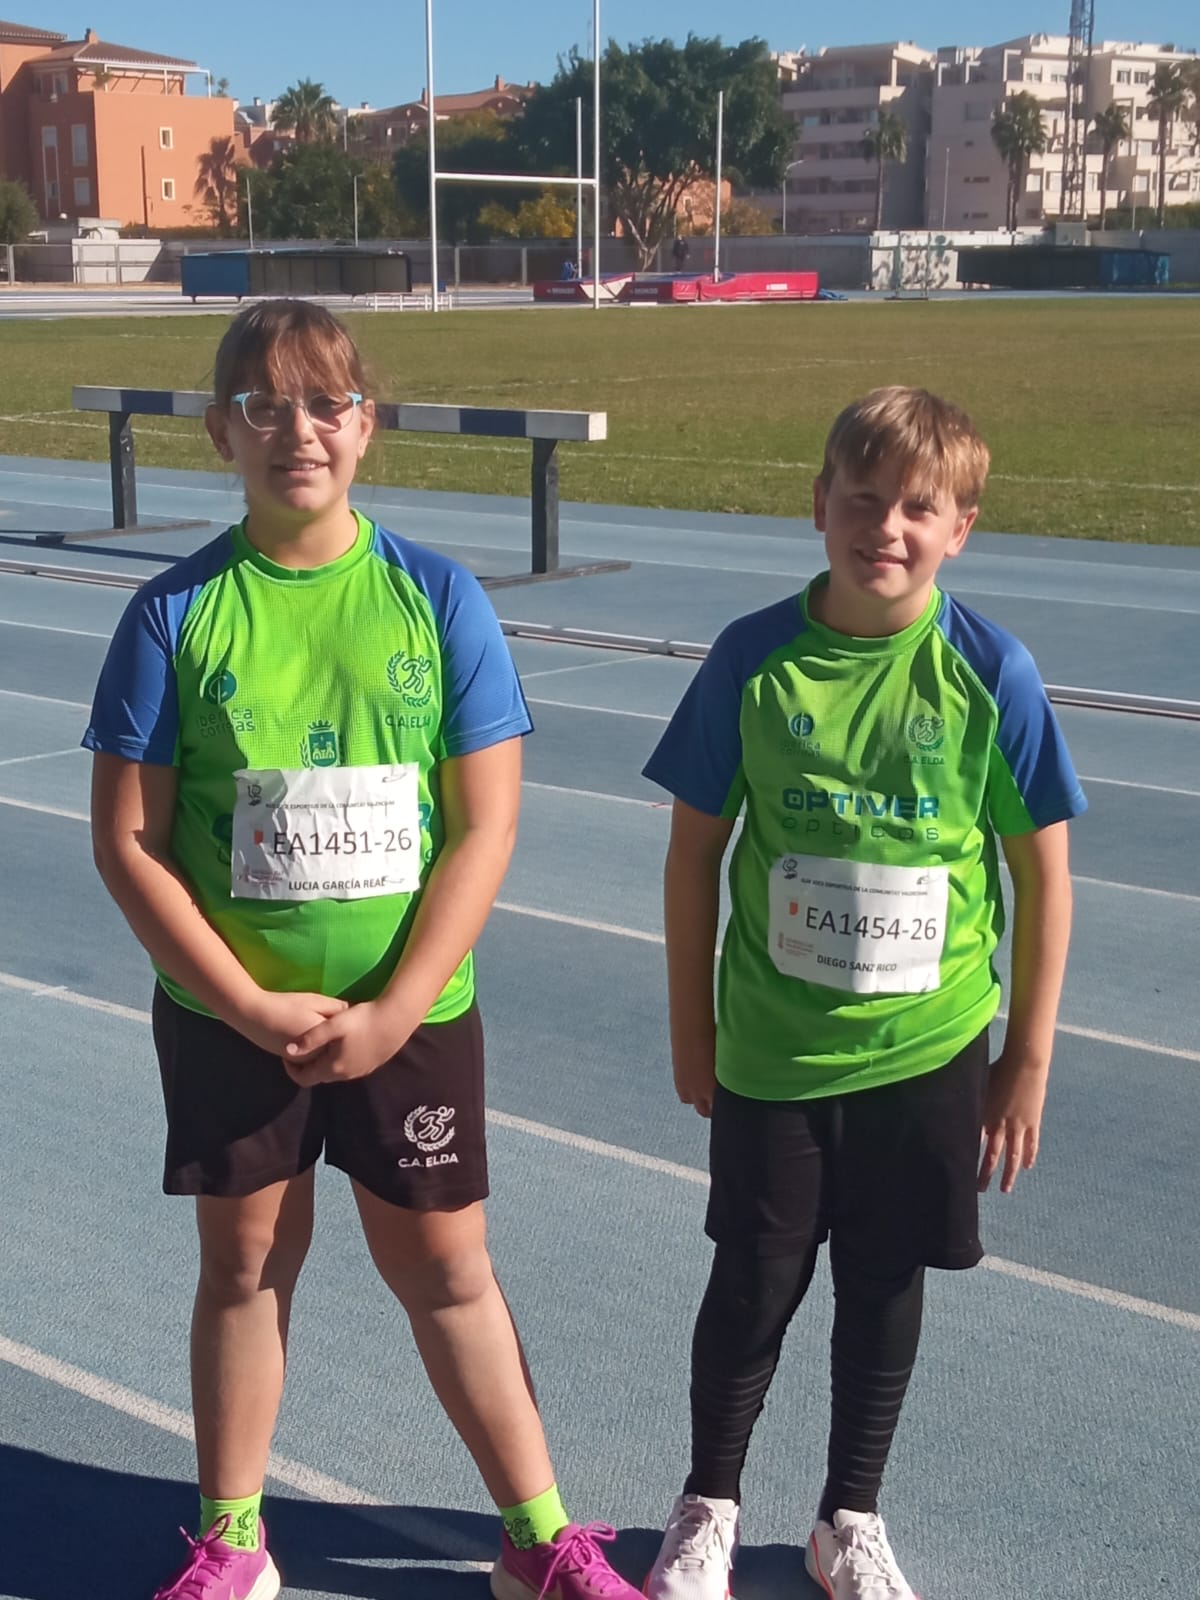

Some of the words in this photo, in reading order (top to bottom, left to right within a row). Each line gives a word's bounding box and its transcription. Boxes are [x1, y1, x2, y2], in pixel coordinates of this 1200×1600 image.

[782, 788, 939, 819] OPTIVER
[273, 828, 413, 857] EA1451-26
[288, 880, 319, 891] LUCIA
[322, 878, 361, 890] GARCÍA
[806, 906, 937, 942] EA1454-26
[817, 954, 847, 970] DIEGO
[849, 961, 875, 973] SANZ
[876, 963, 897, 972] RICO
[398, 1158, 425, 1168] C.A.
[425, 1153, 458, 1168] ELDA
